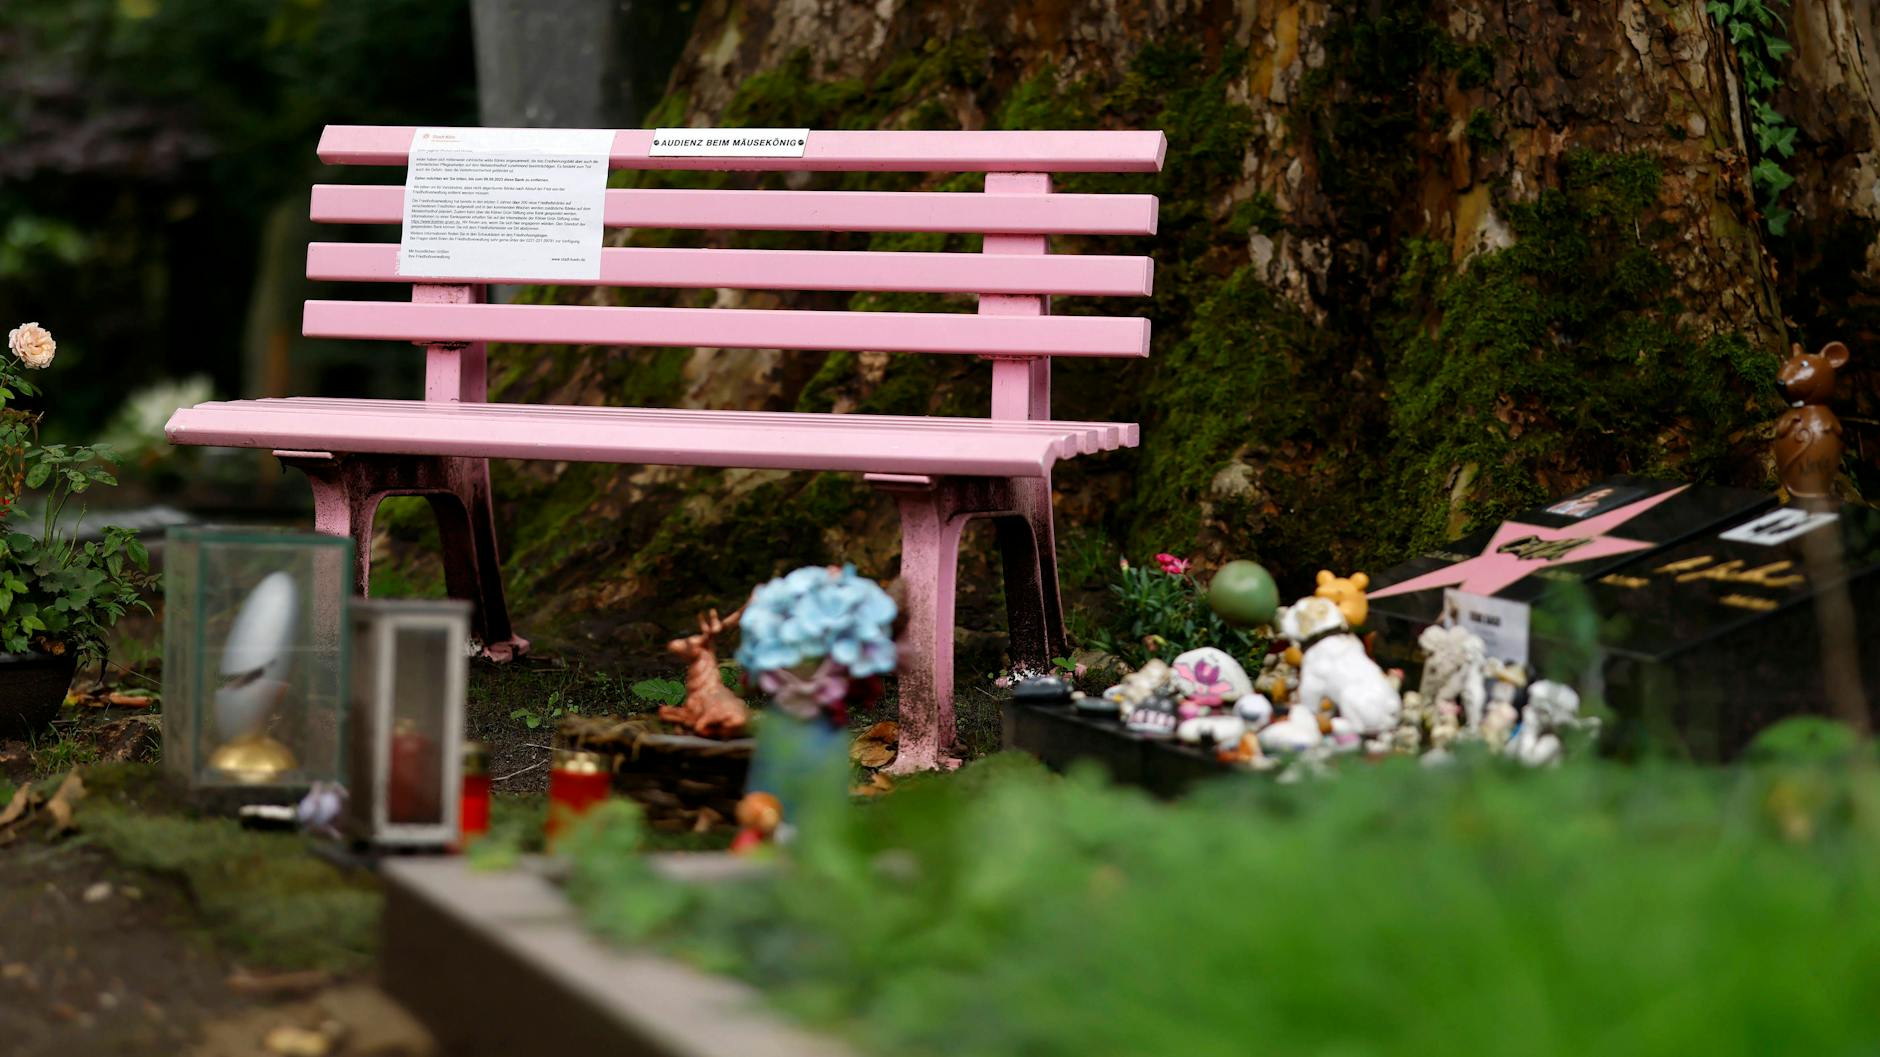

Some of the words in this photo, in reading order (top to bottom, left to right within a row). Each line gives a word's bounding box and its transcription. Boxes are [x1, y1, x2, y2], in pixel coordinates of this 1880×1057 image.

[661, 139, 703, 147] AUDIENZ
[706, 139, 730, 147] BEIM
[732, 137, 797, 147] MÄUSEKÖNIG
